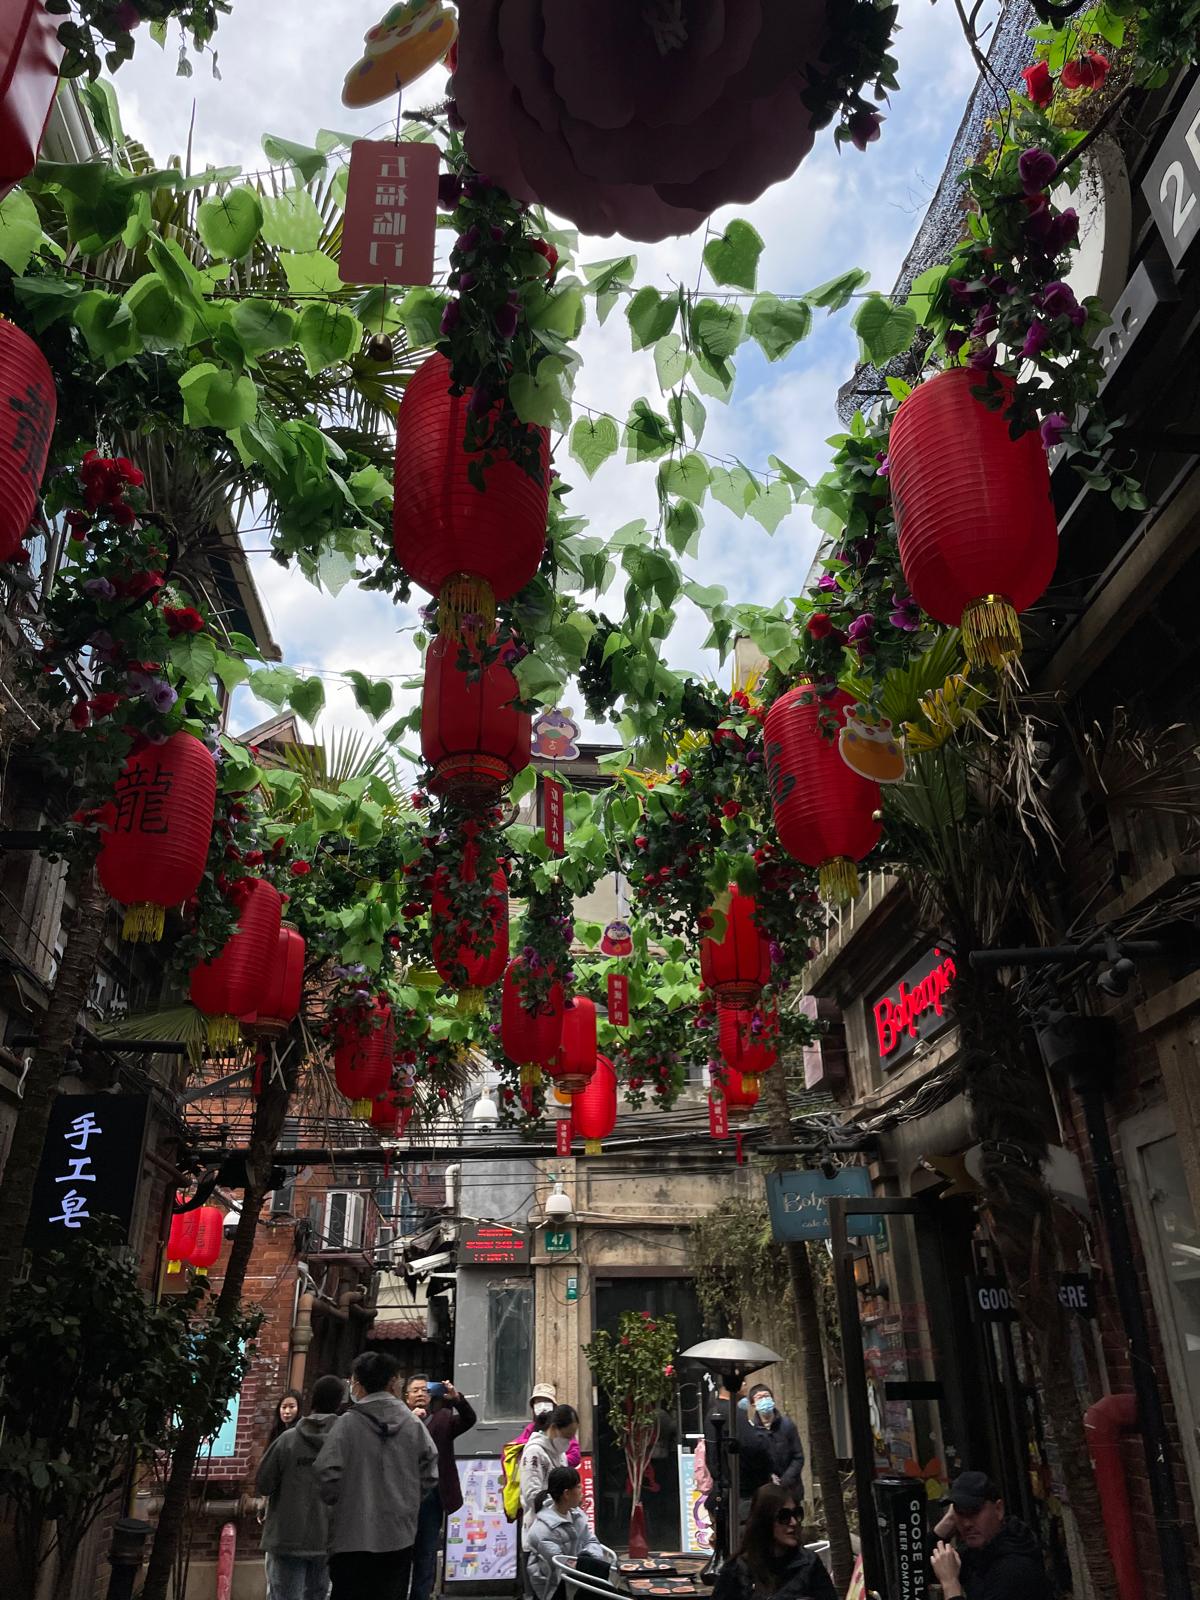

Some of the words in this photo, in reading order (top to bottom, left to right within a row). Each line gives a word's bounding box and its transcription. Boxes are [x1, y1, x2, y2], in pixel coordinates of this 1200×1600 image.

[114, 762, 174, 834] 龍
[48, 1112, 102, 1228] 手工皂
[551, 1233, 565, 1245] 47
[898, 1523, 908, 1551] BEER
[909, 1499, 923, 1562] GOOSE
